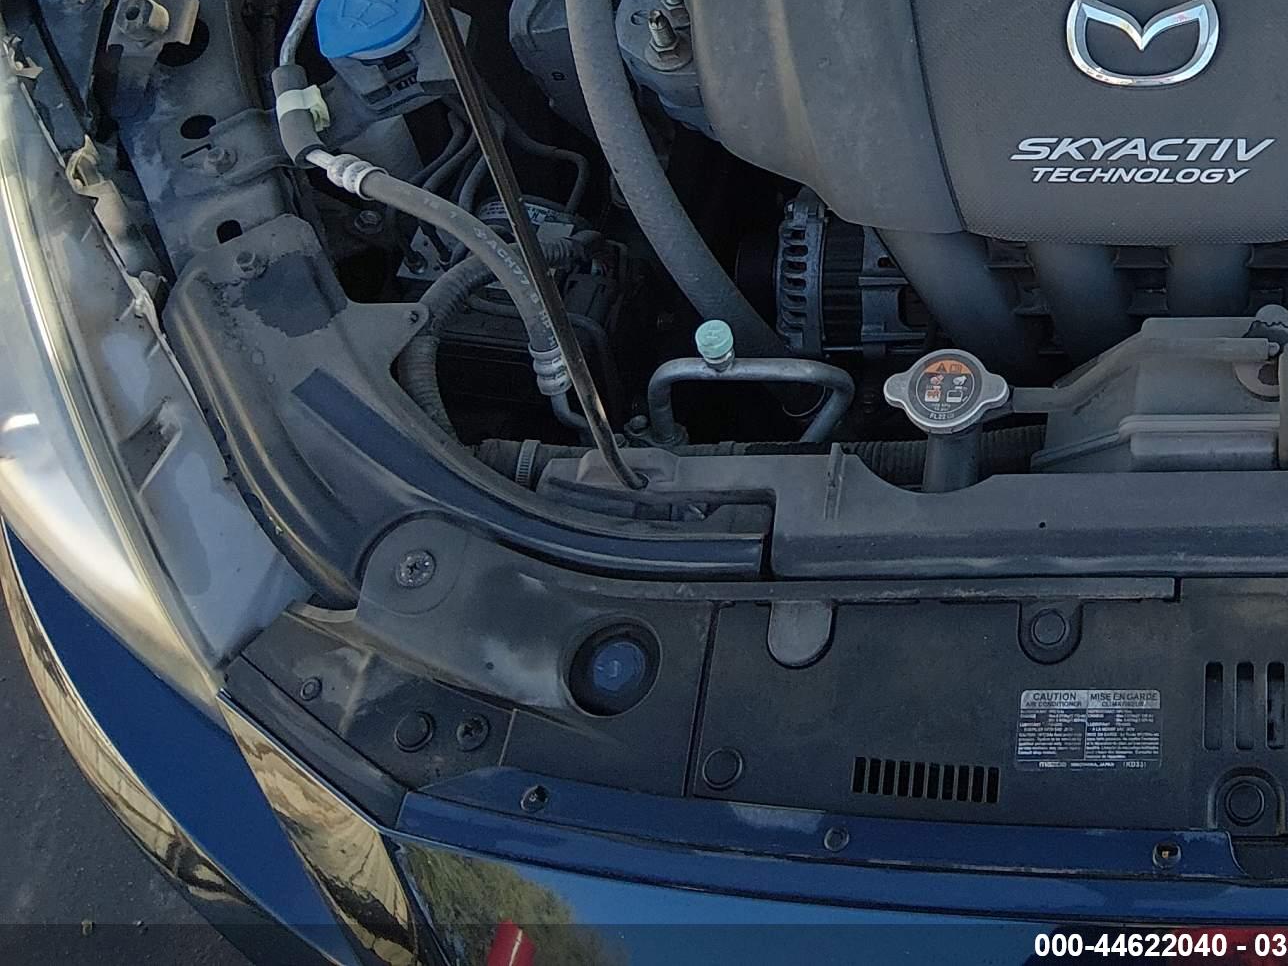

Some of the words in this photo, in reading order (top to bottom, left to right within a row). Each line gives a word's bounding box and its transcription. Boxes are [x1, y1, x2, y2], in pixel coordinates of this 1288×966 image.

[1010, 137, 1276, 162] SKYACTIV
[1032, 166, 1251, 184] TECHNOLOGY
[1033, 692, 1077, 701] CAUTION
[1090, 693, 1111, 701] MISE
[1113, 693, 1125, 701] EN
[1126, 693, 1158, 701] GARDE
